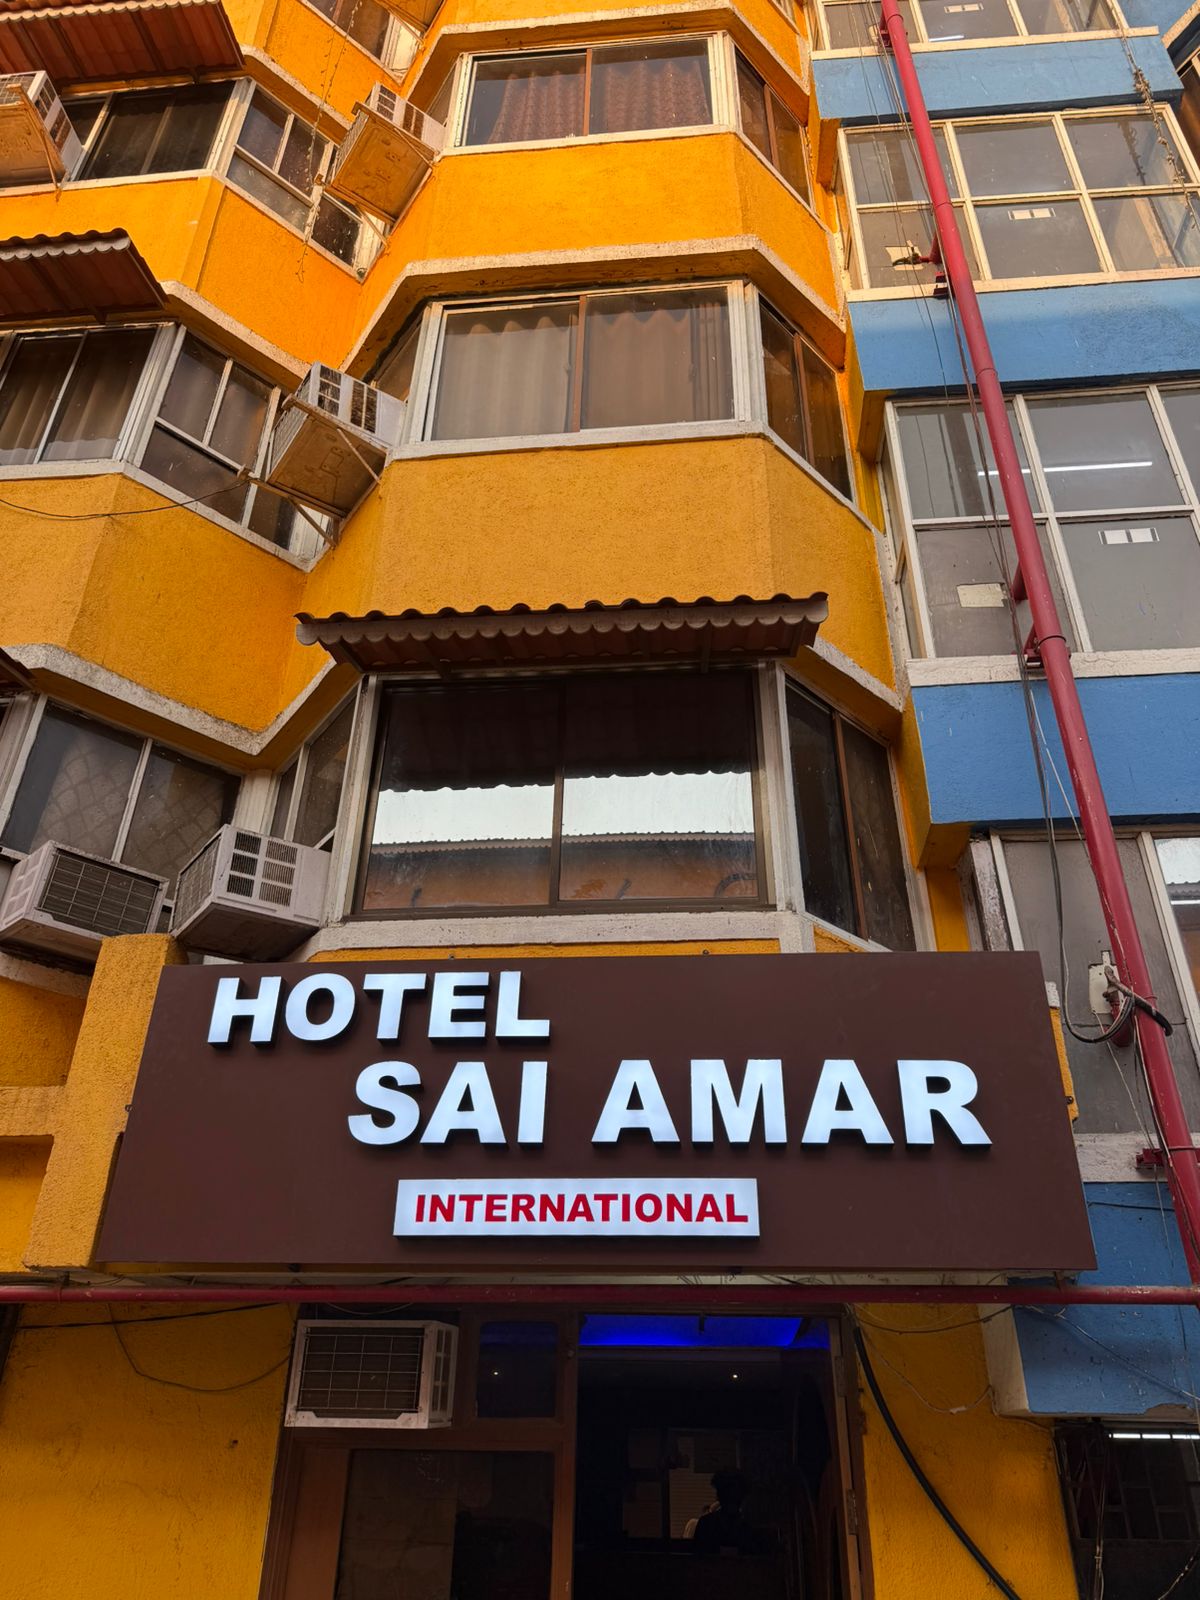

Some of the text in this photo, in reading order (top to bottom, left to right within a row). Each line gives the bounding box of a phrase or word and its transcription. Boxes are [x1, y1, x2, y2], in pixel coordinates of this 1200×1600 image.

[207, 971, 551, 1043] HOTEL
[347, 1058, 993, 1145] SAI AMAR
[414, 1193, 749, 1224] INTERNATIONAL
